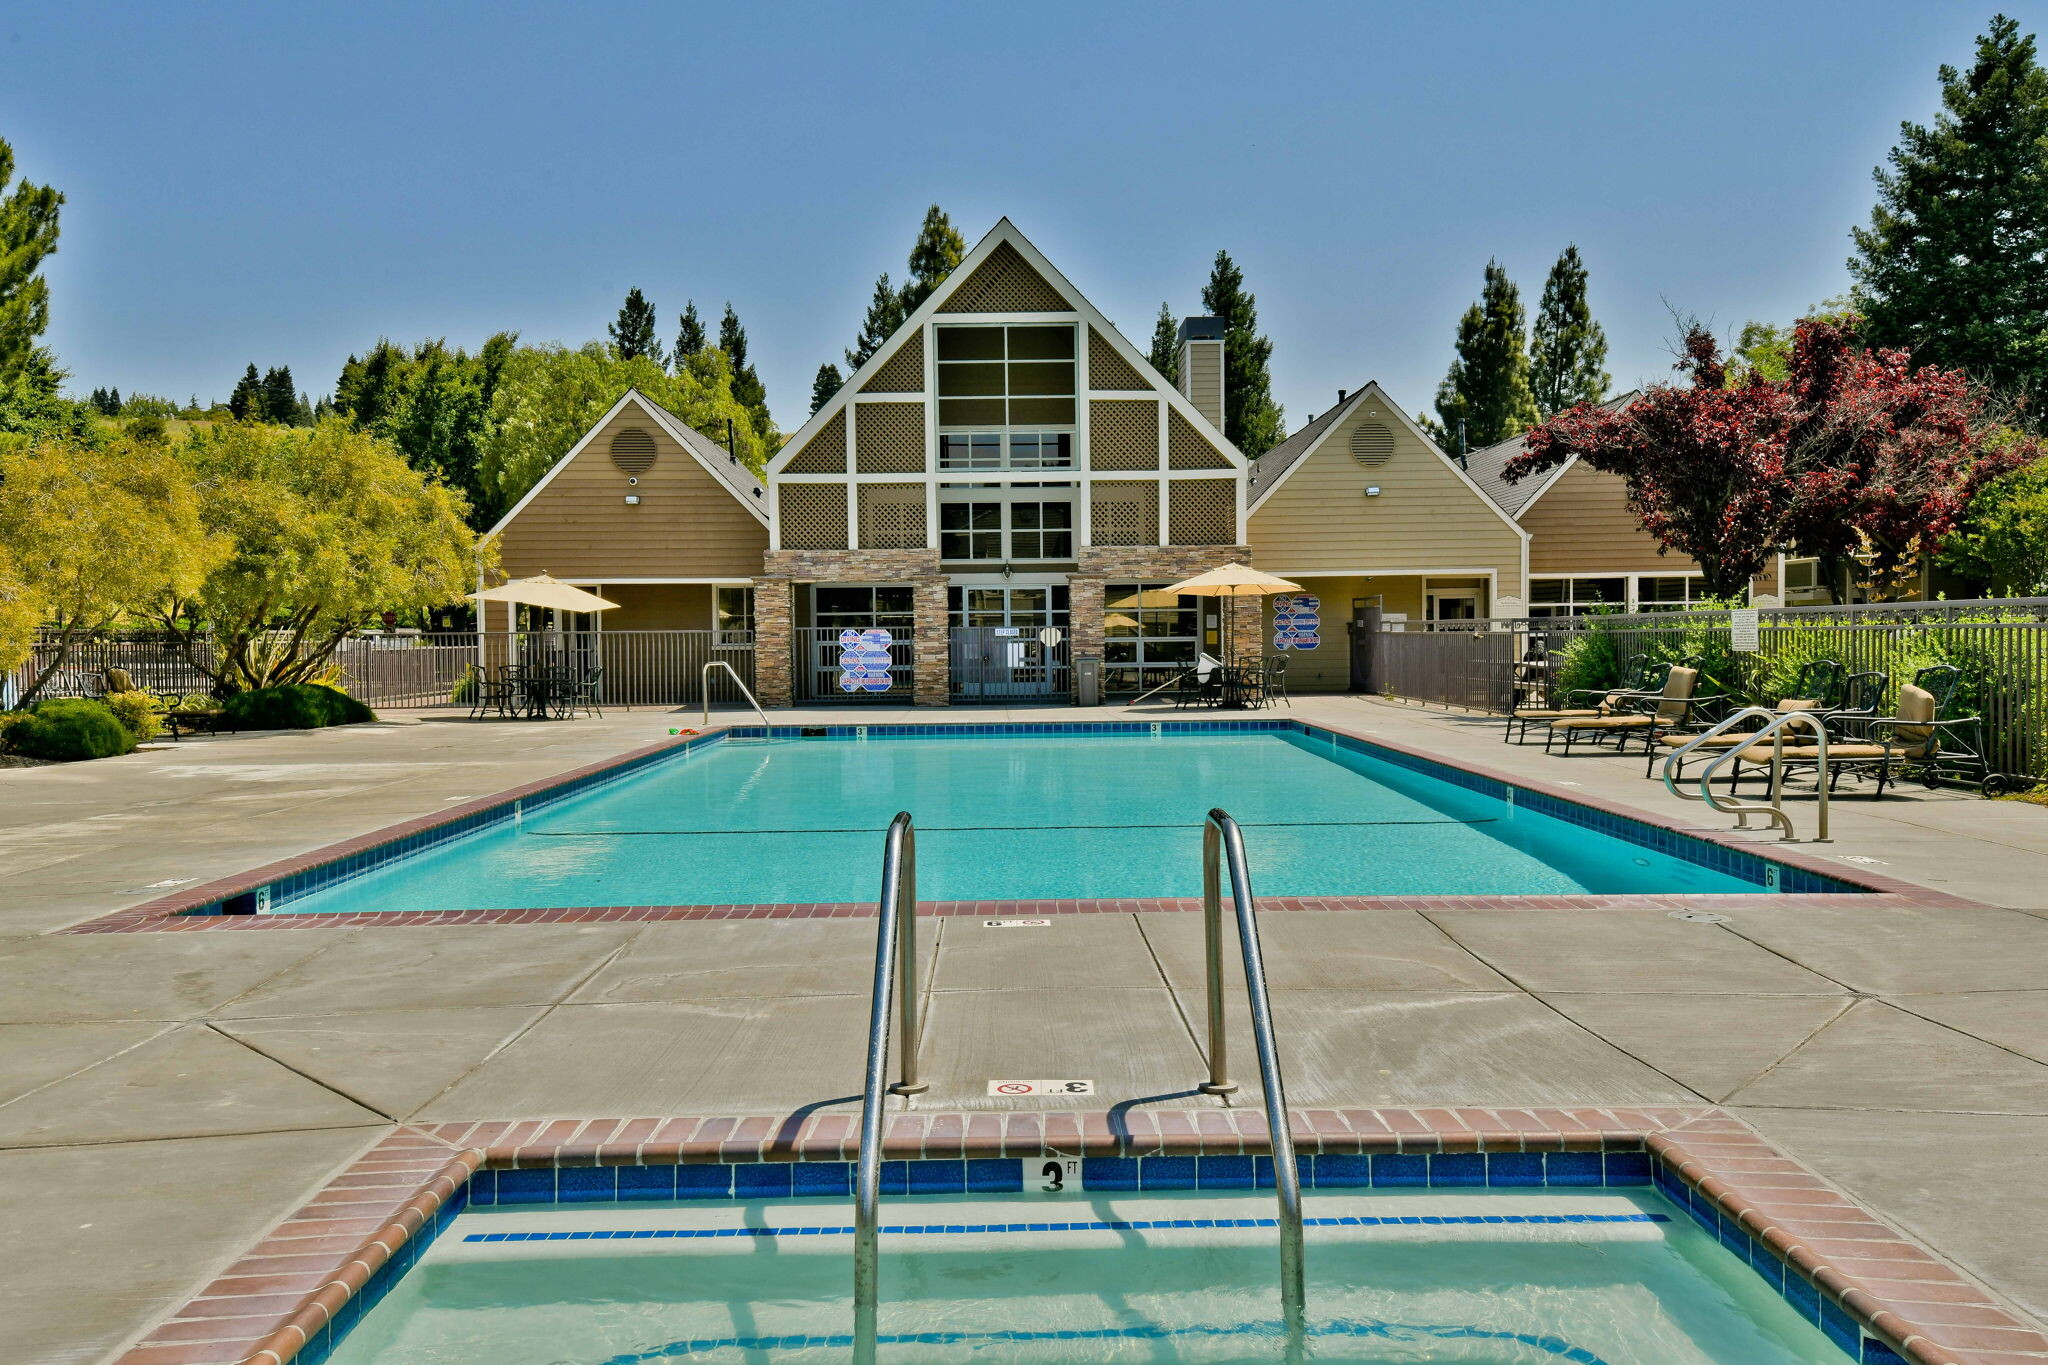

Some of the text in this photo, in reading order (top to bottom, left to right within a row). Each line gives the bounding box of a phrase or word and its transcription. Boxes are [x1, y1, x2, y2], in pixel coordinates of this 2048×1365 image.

[857, 727, 862, 735] 3
[1151, 723, 1157, 731] 3
[1767, 867, 1773, 886] 6
[258, 891, 264, 910] 6
[1065, 1082, 1088, 1093] 3
[1042, 1161, 1078, 1192] 3 FT
